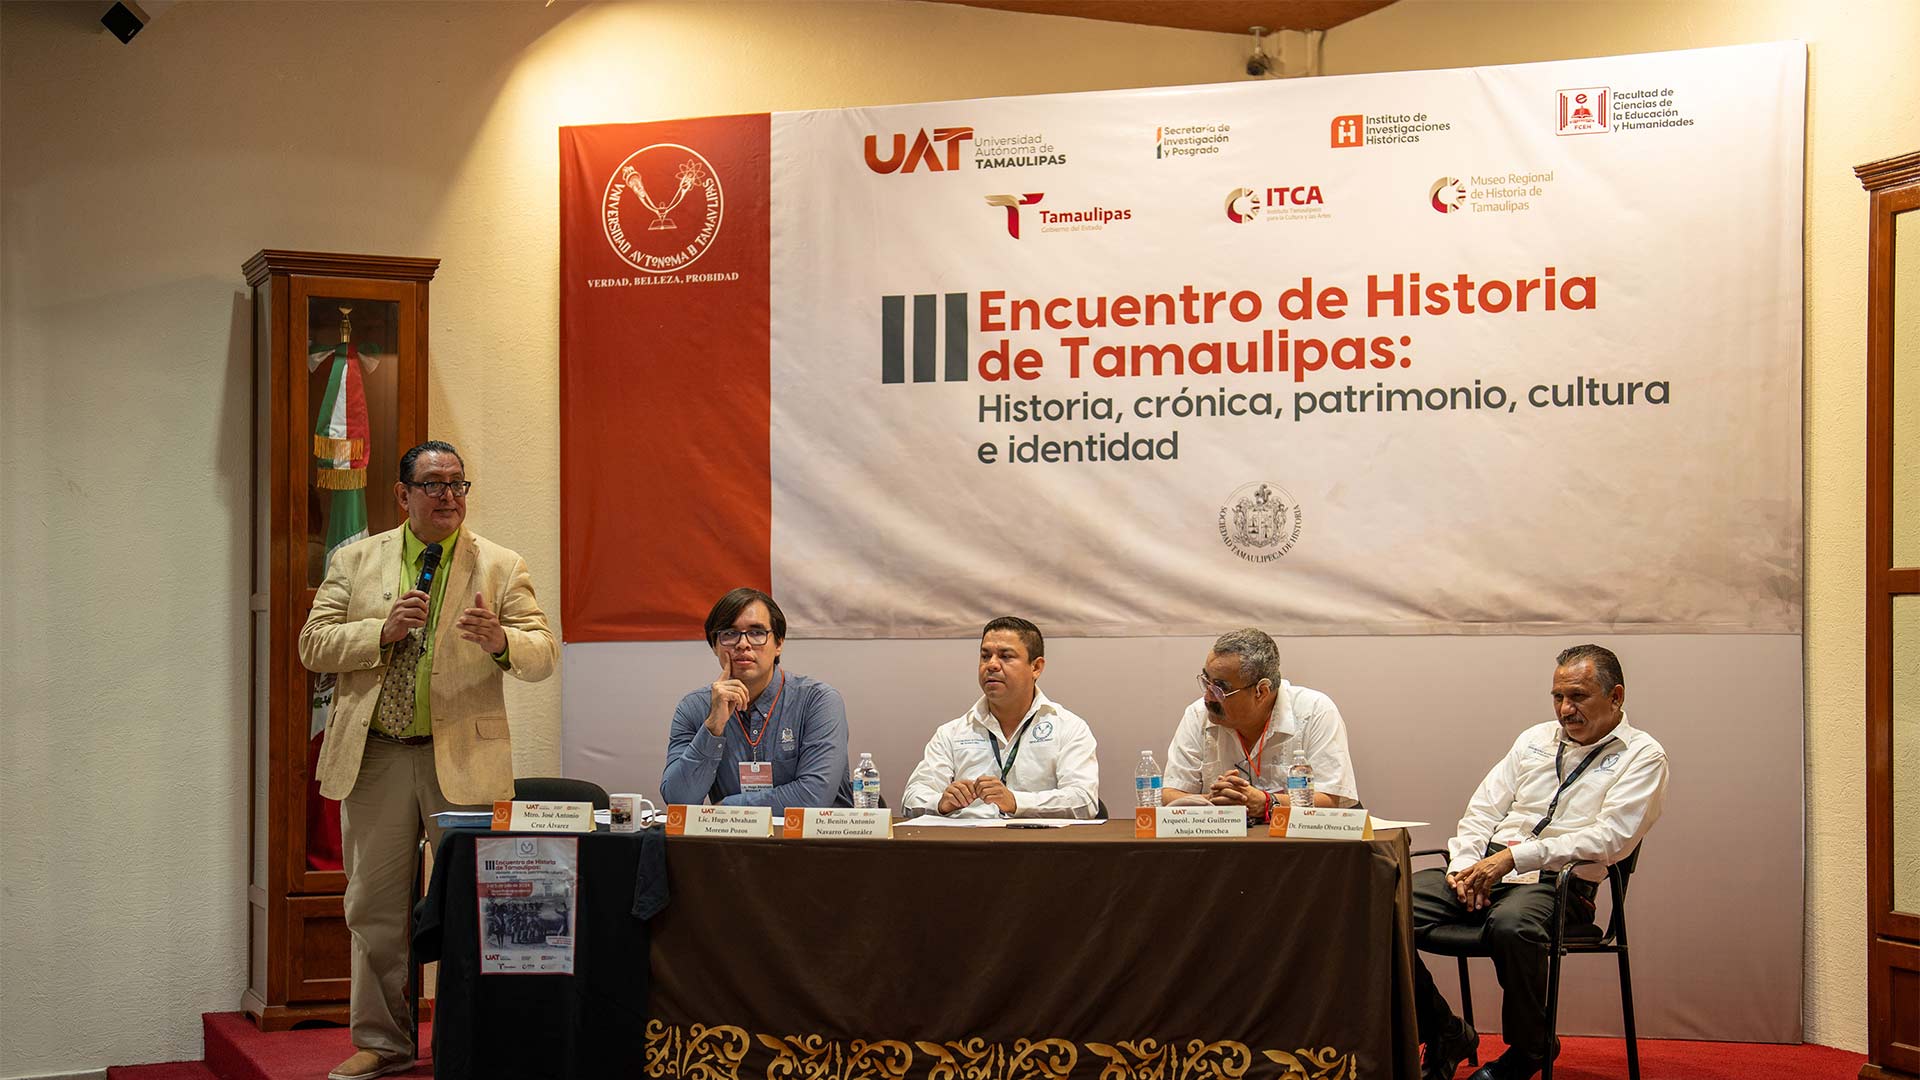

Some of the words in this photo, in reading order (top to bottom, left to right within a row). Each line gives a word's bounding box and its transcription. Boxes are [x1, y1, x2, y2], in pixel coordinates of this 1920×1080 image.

[1613, 89, 1659, 100] Facultad
[1660, 88, 1674, 96] de
[1613, 99, 1658, 110] Ciencias
[1659, 98, 1673, 107] de
[1366, 114, 1411, 124] Instituto
[1412, 112, 1428, 122] de
[1613, 112, 1623, 120] la
[1624, 108, 1679, 120] Educación
[1218, 124, 1230, 132] de
[1366, 122, 1451, 135] Investigaciones
[1613, 123, 1620, 132] y
[1622, 118, 1695, 130] Humanidades
[974, 134, 1042, 148] Universidad
[1164, 134, 1229, 146] Investigación
[1366, 133, 1420, 145] Históricas
[864, 127, 975, 174] UAT
[975, 145, 1036, 157] Autónoma
[1039, 144, 1054, 153] de
[1164, 148, 1170, 158] y
[1172, 145, 1219, 156] Posgrado
[976, 154, 1066, 170] TAMAULIPAS
[1470, 176, 1506, 186] Museo
[1508, 170, 1554, 186] Regional
[1266, 186, 1324, 206] ITCA
[1470, 188, 1484, 200] de
[1486, 186, 1527, 198] Historia
[1529, 186, 1543, 196] de
[1471, 200, 1530, 213] Tamaulipas
[1040, 206, 1132, 224] Tamaulipas
[686, 272, 740, 283] PROBIDAD
[979, 284, 1263, 332] Encuentro
[1278, 276, 1348, 321] de
[1366, 266, 1597, 318] Historia
[882, 292, 969, 384] III
[978, 339, 1044, 382] de
[1060, 329, 1412, 383] Tamaulipas:
[978, 391, 1124, 424] Historia,
[1133, 387, 1284, 420] crónica,
[1294, 379, 1518, 422] patrimonio,
[1528, 376, 1671, 408] cultura
[977, 441, 998, 464] e
[1008, 430, 1179, 464] identidad
